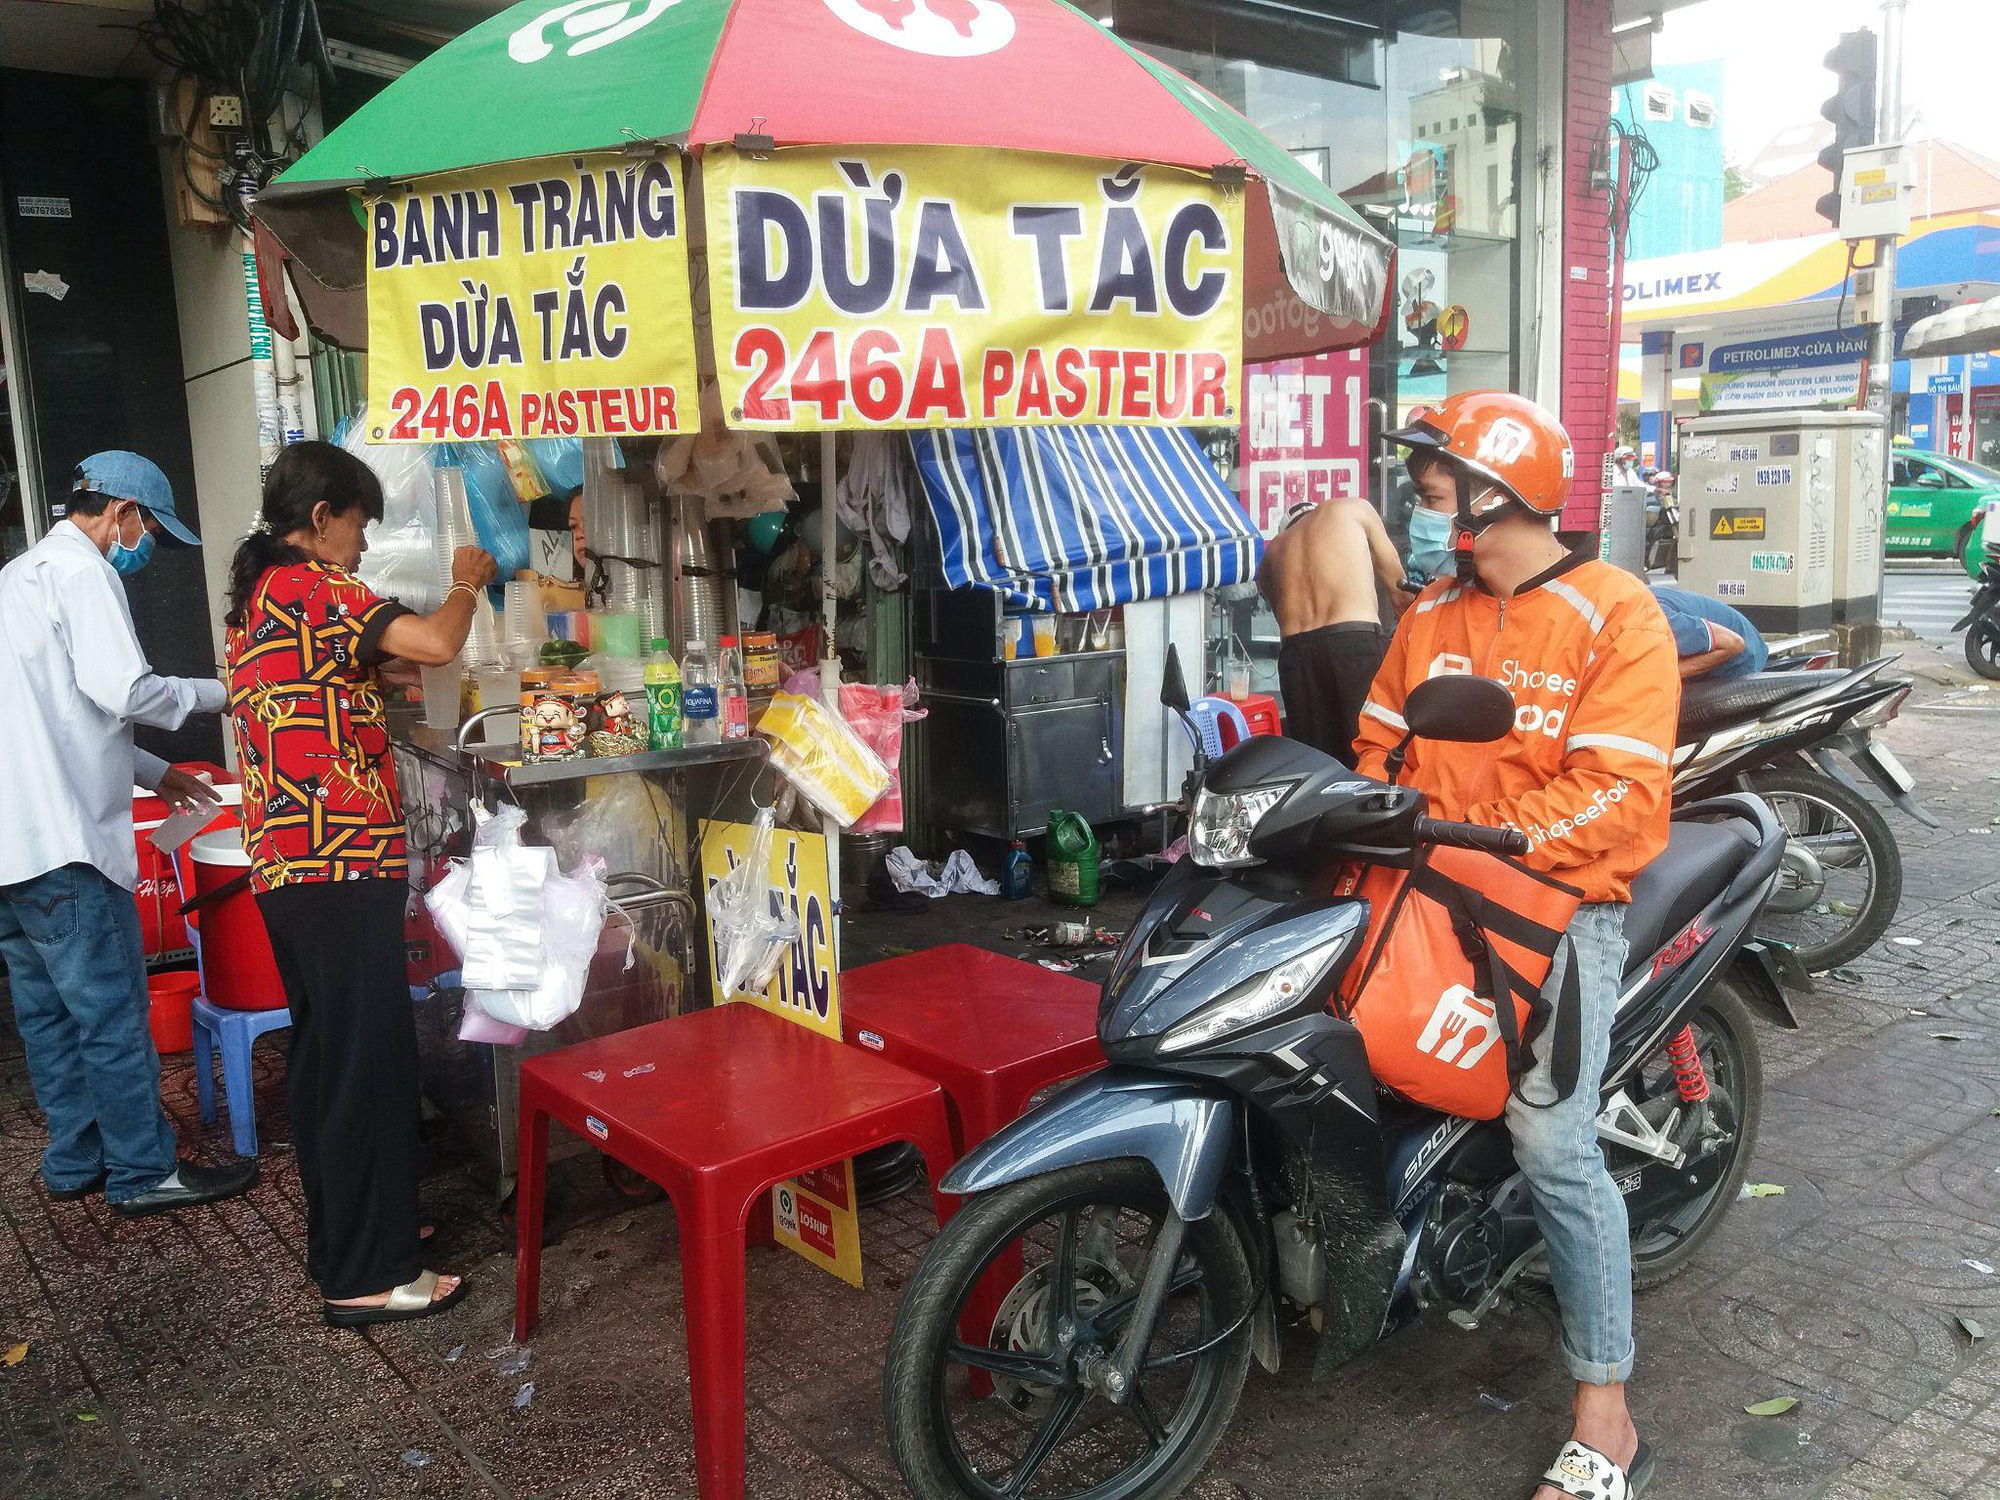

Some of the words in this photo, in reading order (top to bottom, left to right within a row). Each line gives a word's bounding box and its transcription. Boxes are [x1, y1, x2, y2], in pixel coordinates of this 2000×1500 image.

[734, 161, 986, 314] DỪA
[1013, 164, 1229, 318] TẮC
[419, 279, 523, 370] DỪA
[533, 256, 628, 362] TẮC
[1621, 271, 1722, 302] OLIMEX
[734, 327, 970, 420] 246A
[983, 348, 1227, 418] PASTEUR
[388, 380, 513, 440] 246A
[521, 386, 678, 436] PASTEUR
[1250, 374, 1331, 449] GET
[1346, 375, 1360, 447] 1
[541, 529, 562, 566] AL
[685, 697, 713, 706] AQUAFINA
[1405, 1115, 1464, 1182] SPOR
[800, 1211, 829, 1236] LOSHIP
[1395, 1180, 1438, 1221] ONDA
